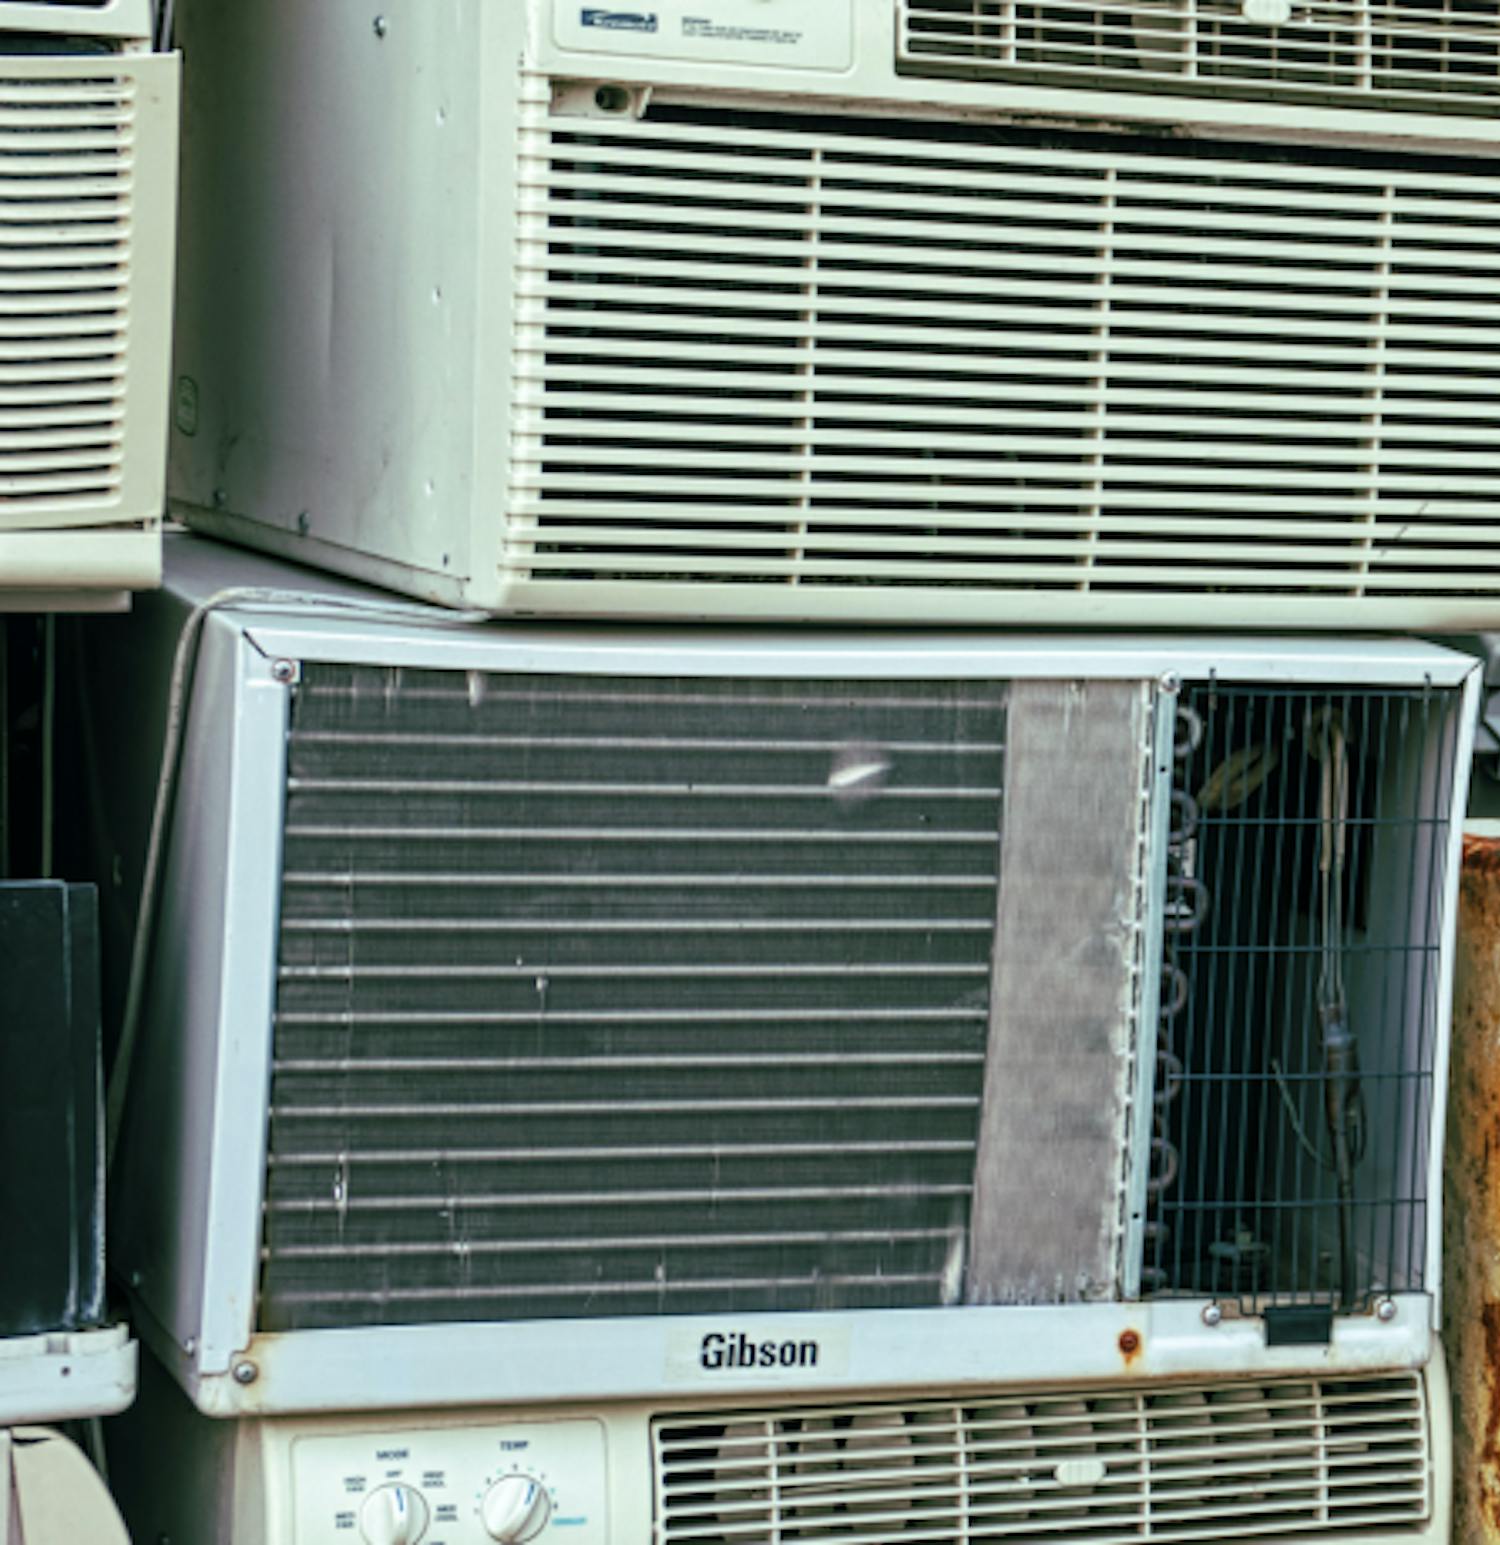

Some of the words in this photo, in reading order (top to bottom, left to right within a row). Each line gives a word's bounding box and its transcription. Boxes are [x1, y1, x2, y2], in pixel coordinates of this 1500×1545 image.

[700, 1333, 819, 1369] Gibson
[499, 1440, 530, 1451] TEMP
[376, 1449, 409, 1460] MODE
